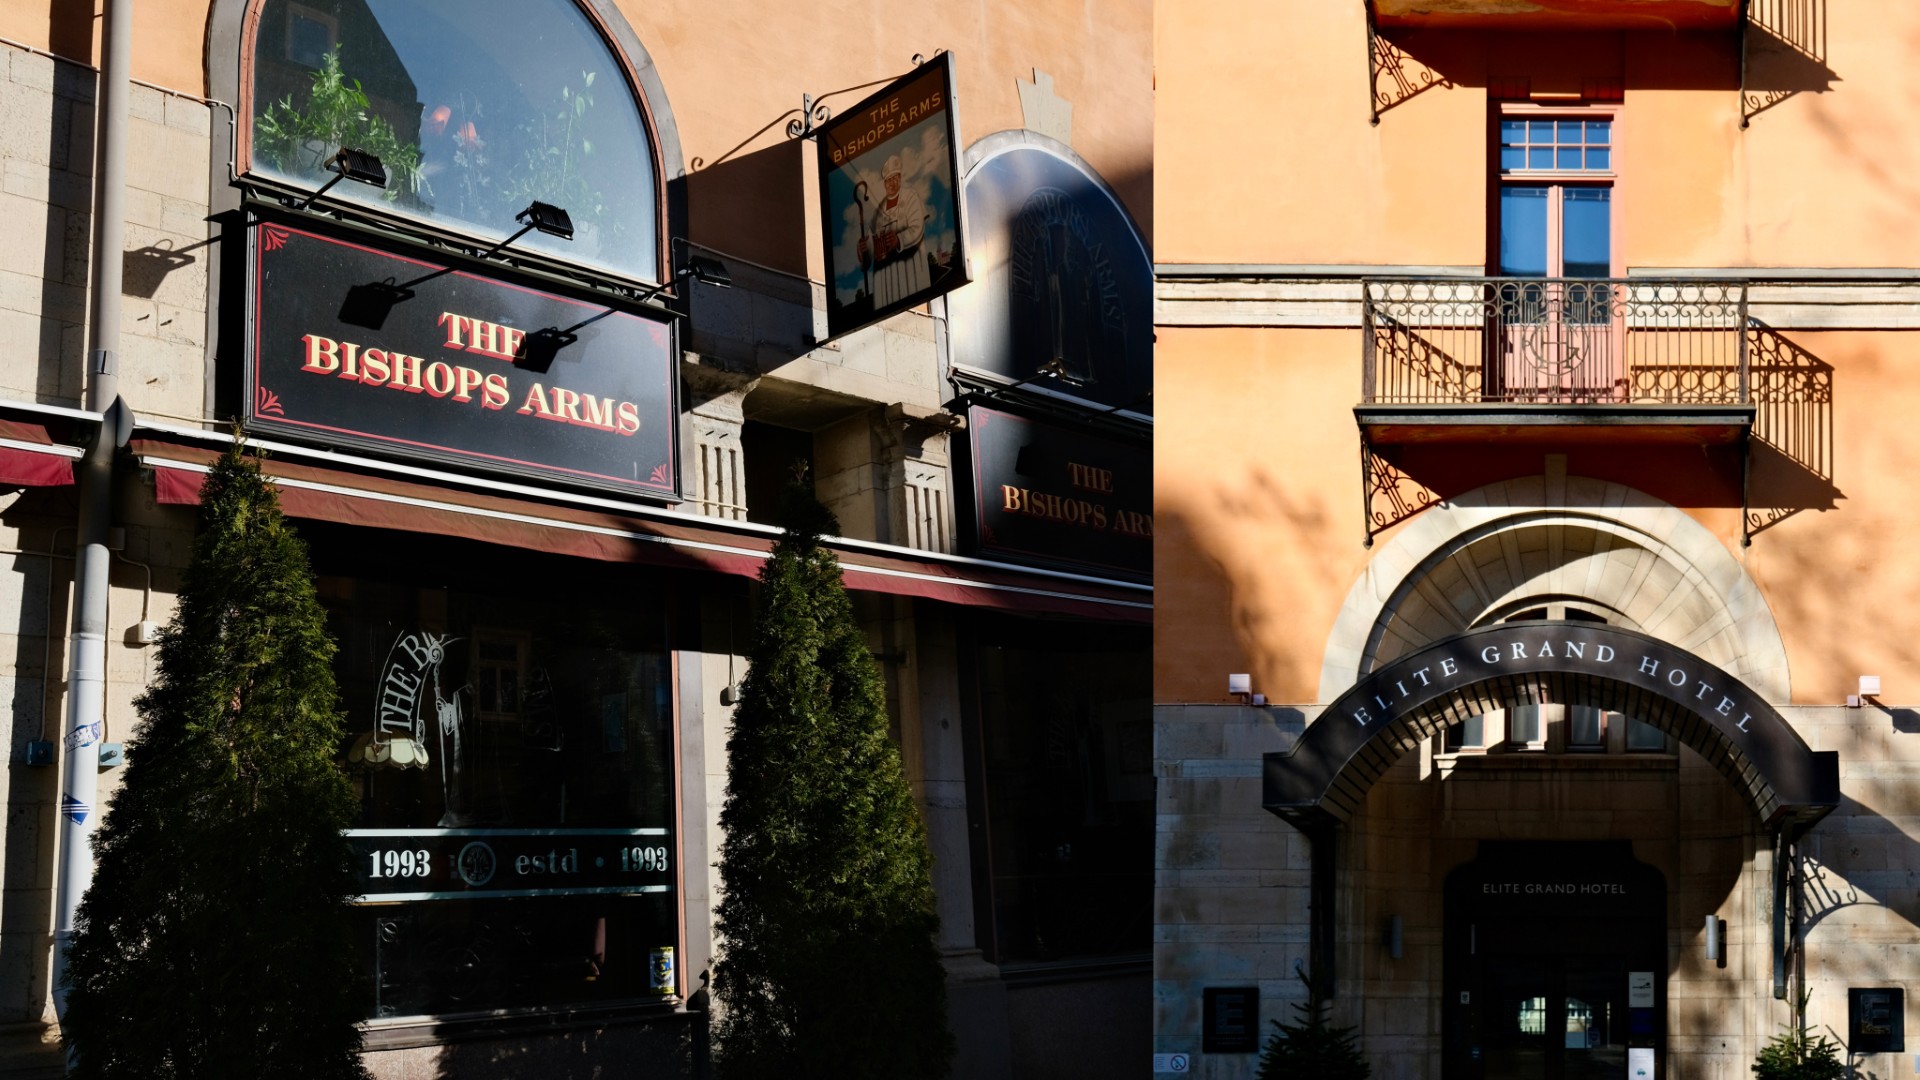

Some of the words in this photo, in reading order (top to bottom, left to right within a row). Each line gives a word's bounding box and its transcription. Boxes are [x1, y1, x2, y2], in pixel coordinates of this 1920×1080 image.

[833, 119, 895, 163] BISHOPS
[898, 92, 942, 127] ARMS
[870, 97, 900, 123] THE
[437, 311, 527, 362] THE
[301, 333, 510, 412] BISHOPS
[515, 382, 641, 437] ARMS
[1067, 461, 1114, 496] THE
[1000, 483, 1108, 532] BISHOPS
[380, 663, 423, 734] THE
[1353, 657, 1458, 727] ELITE
[1481, 639, 1616, 665] GRAND
[1637, 655, 1752, 734] HOTEL
[369, 849, 431, 879] 1993
[514, 847, 578, 875] estd
[619, 845, 669, 873] 1993
[1482, 883, 1520, 895] ELITE
[1524, 883, 1577, 895] GRAND
[1580, 883, 1627, 895] HOTEL
